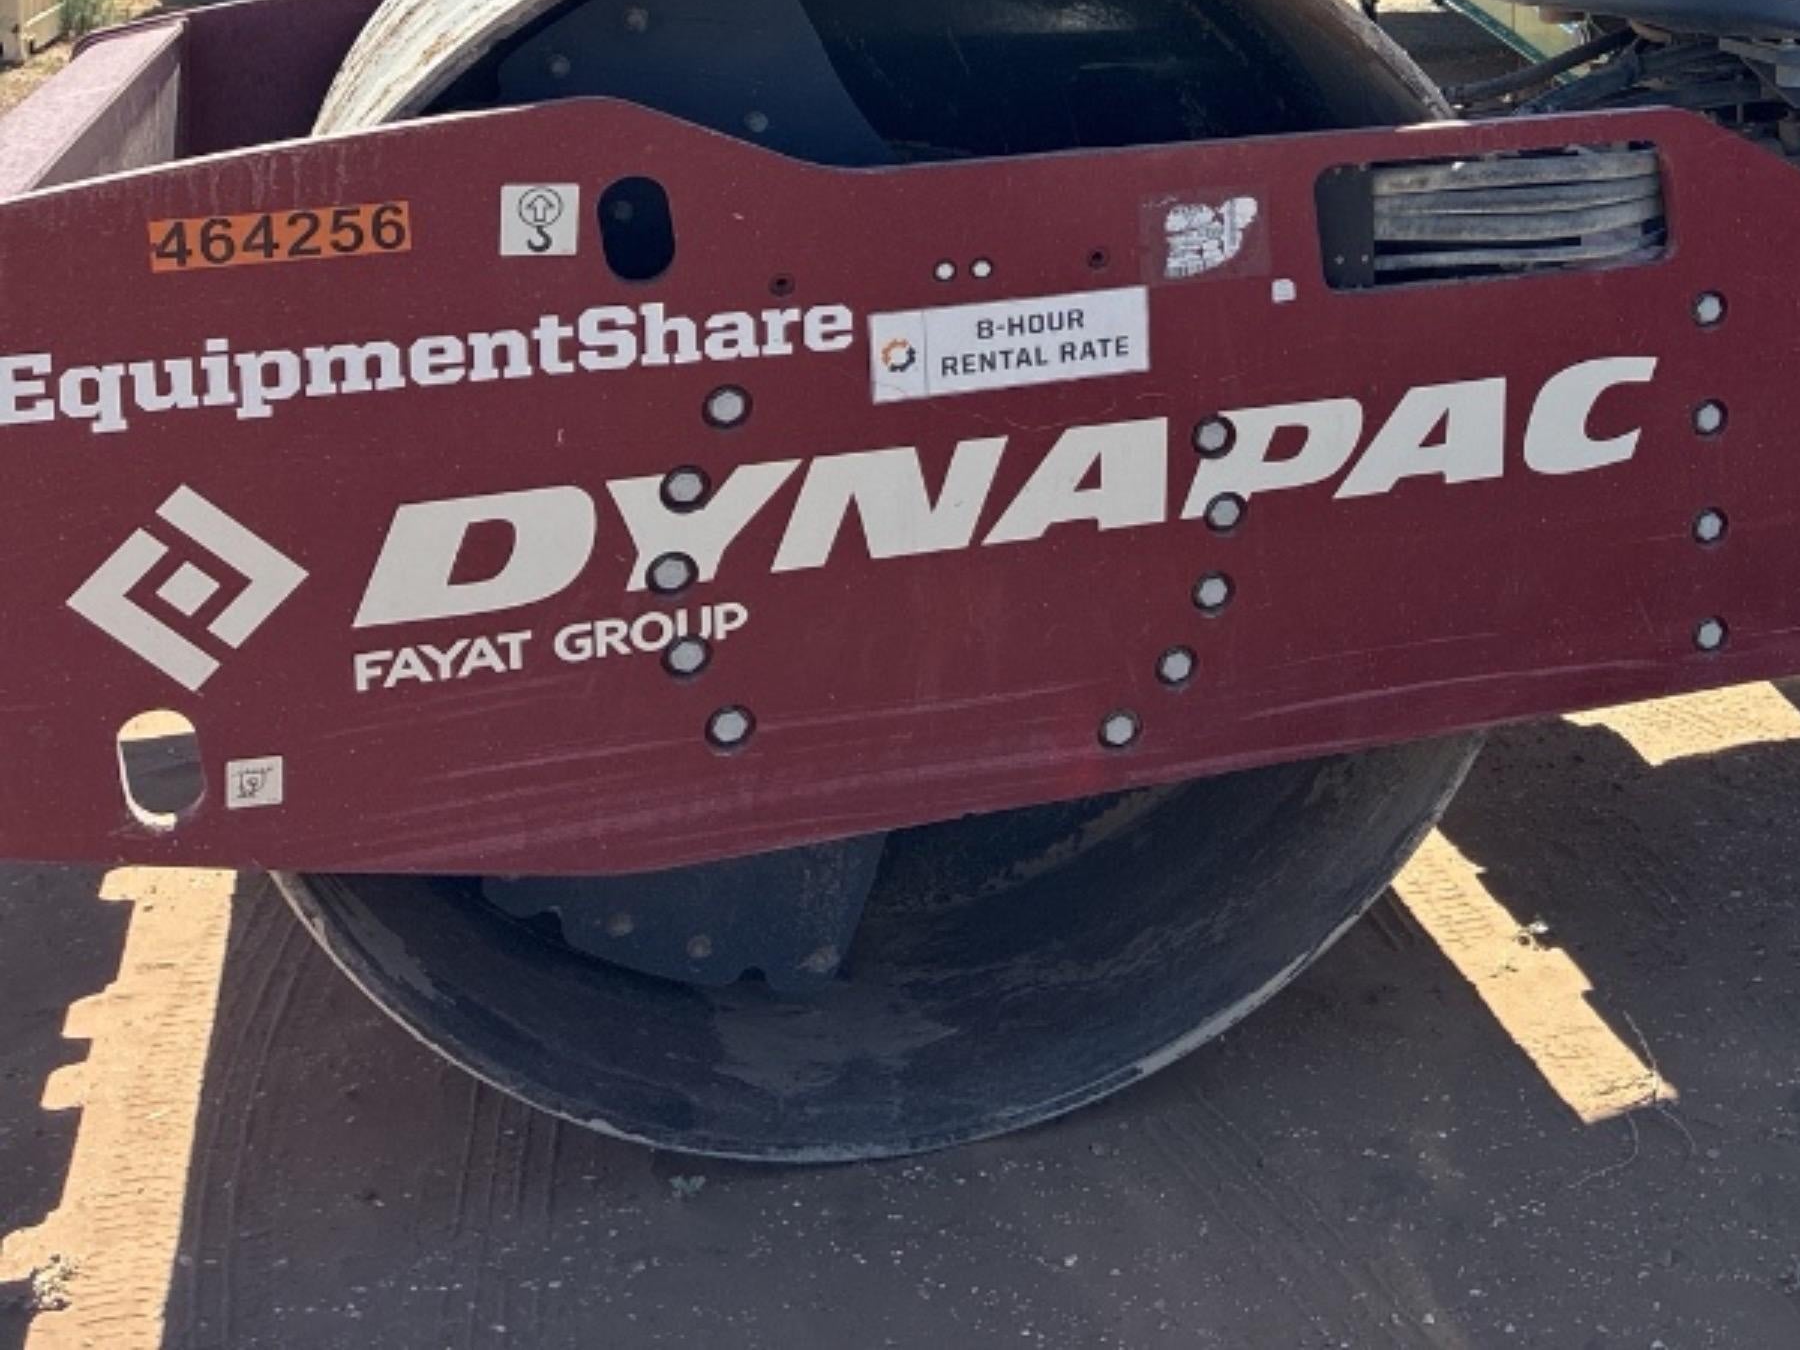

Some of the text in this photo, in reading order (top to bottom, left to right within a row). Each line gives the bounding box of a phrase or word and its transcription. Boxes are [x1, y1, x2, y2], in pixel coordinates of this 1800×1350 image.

[153, 203, 407, 268] 464256
[0, 302, 855, 434] EquipmentShare
[940, 335, 1130, 378] RENTAL RATE
[352, 354, 1659, 629] DYNAPAC
[354, 601, 750, 692] FAYAT GROUP
